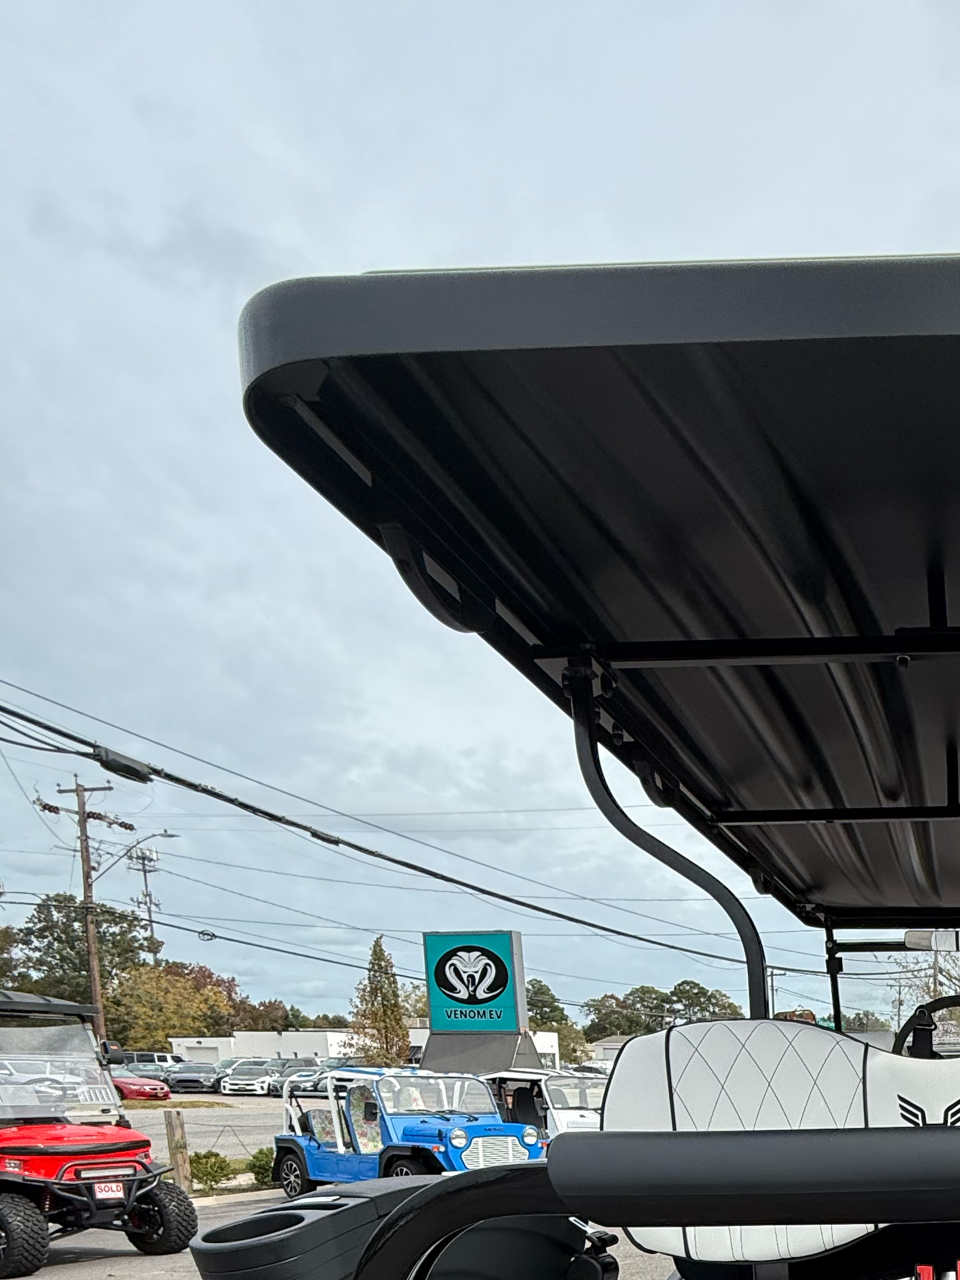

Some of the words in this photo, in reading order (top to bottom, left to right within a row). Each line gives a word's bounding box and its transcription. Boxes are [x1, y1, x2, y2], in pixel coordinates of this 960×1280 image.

[445, 1009, 487, 1019] VENOM
[488, 1009, 503, 1020] EV
[97, 1184, 122, 1193] SOLD
